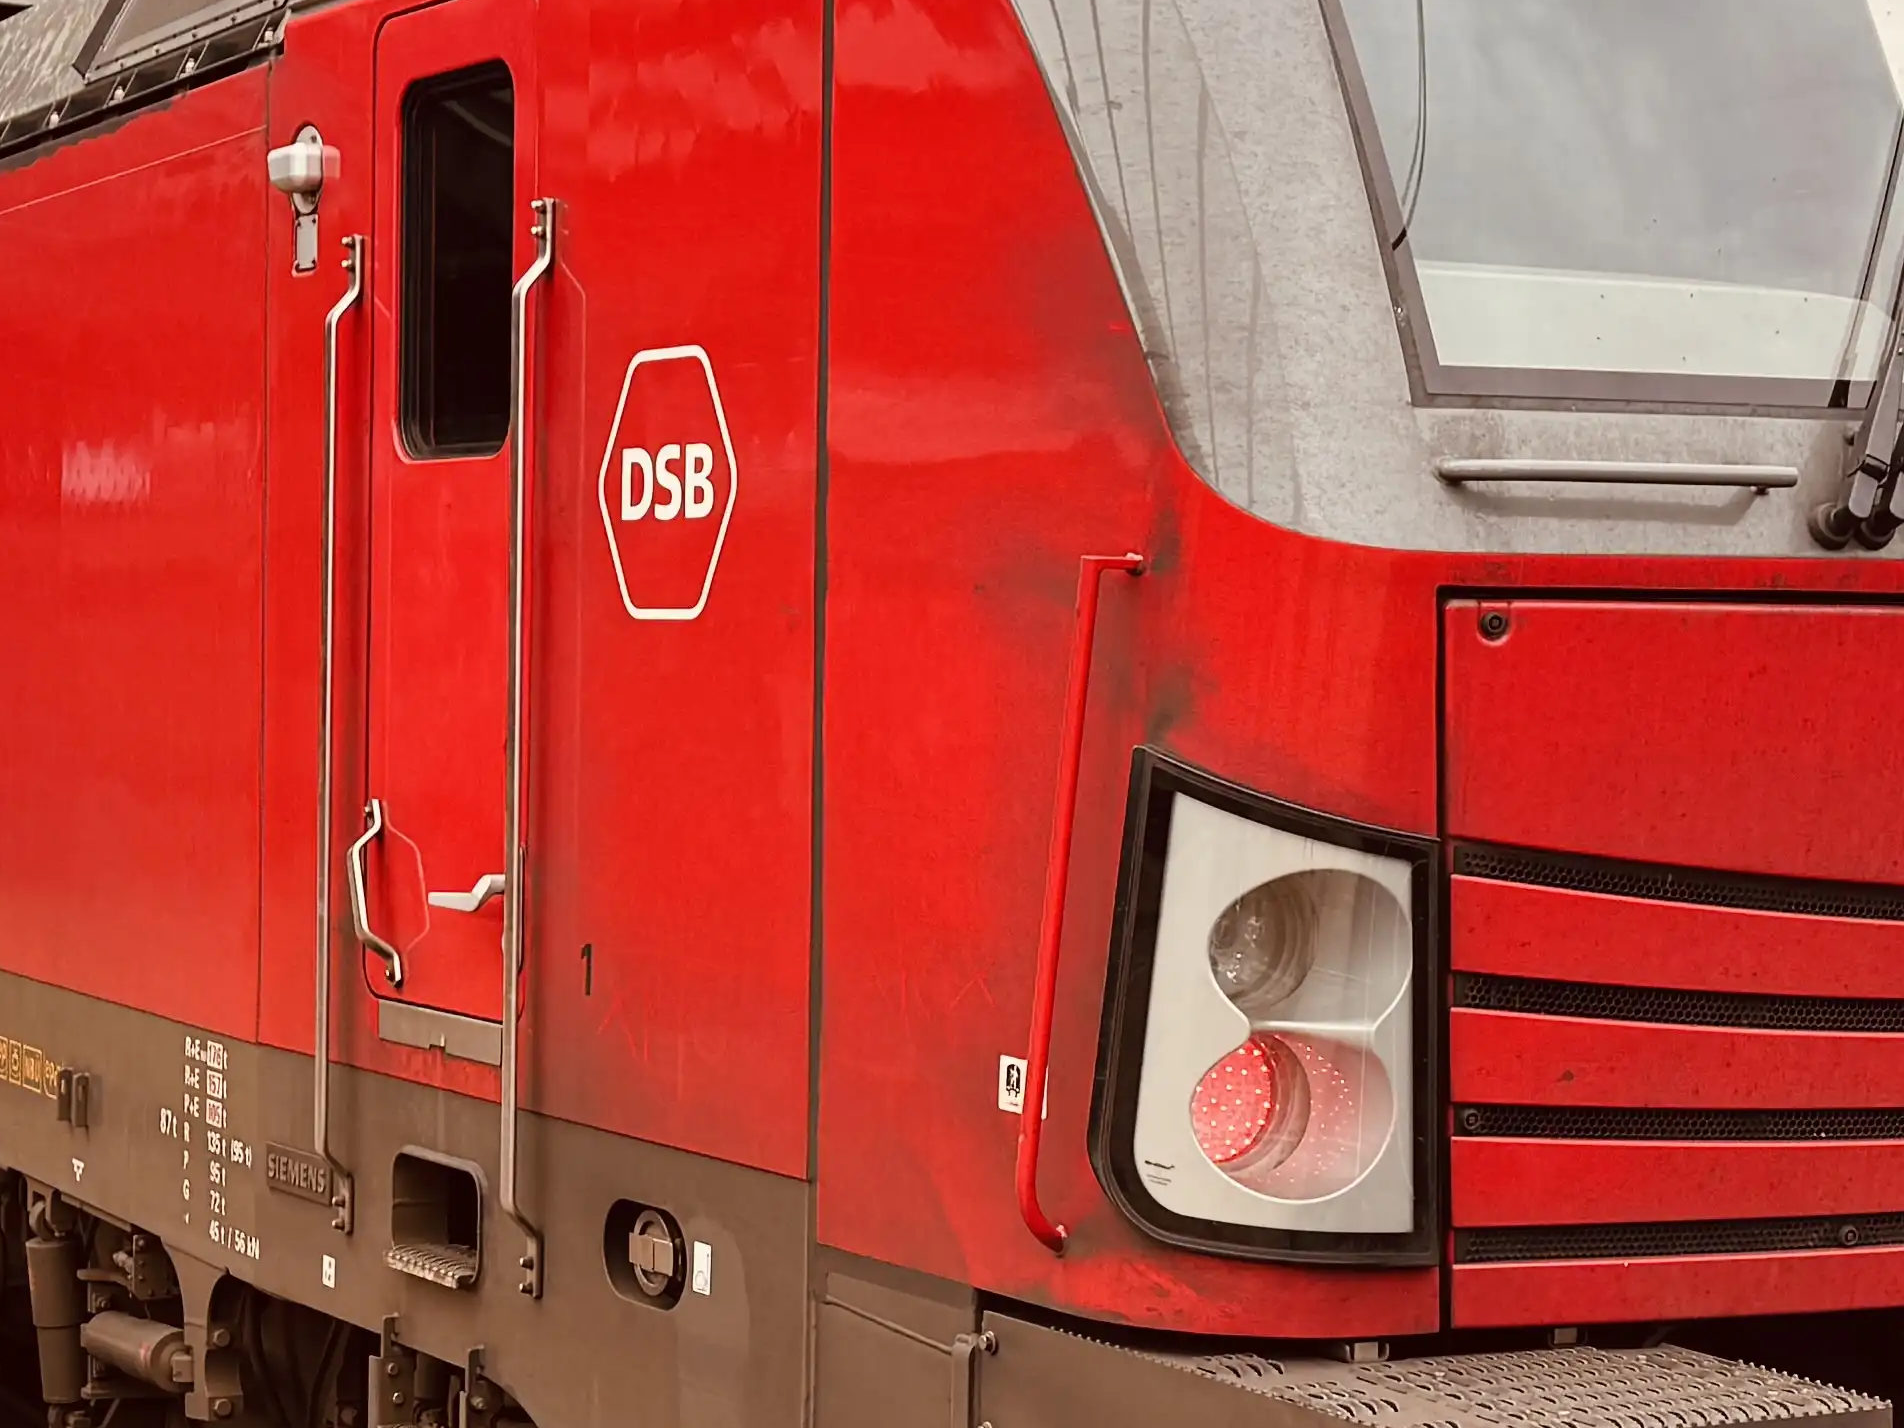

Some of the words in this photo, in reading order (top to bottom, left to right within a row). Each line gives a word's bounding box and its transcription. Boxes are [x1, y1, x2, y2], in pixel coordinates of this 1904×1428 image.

[620, 442, 715, 521] DSB
[581, 943, 592, 996] 1
[159, 1107, 172, 1135] 87
[267, 1154, 326, 1194] SIEMENS
[183, 1179, 190, 1201] G
[209, 1190, 220, 1213] 72
[234, 1229, 246, 1254] 56
